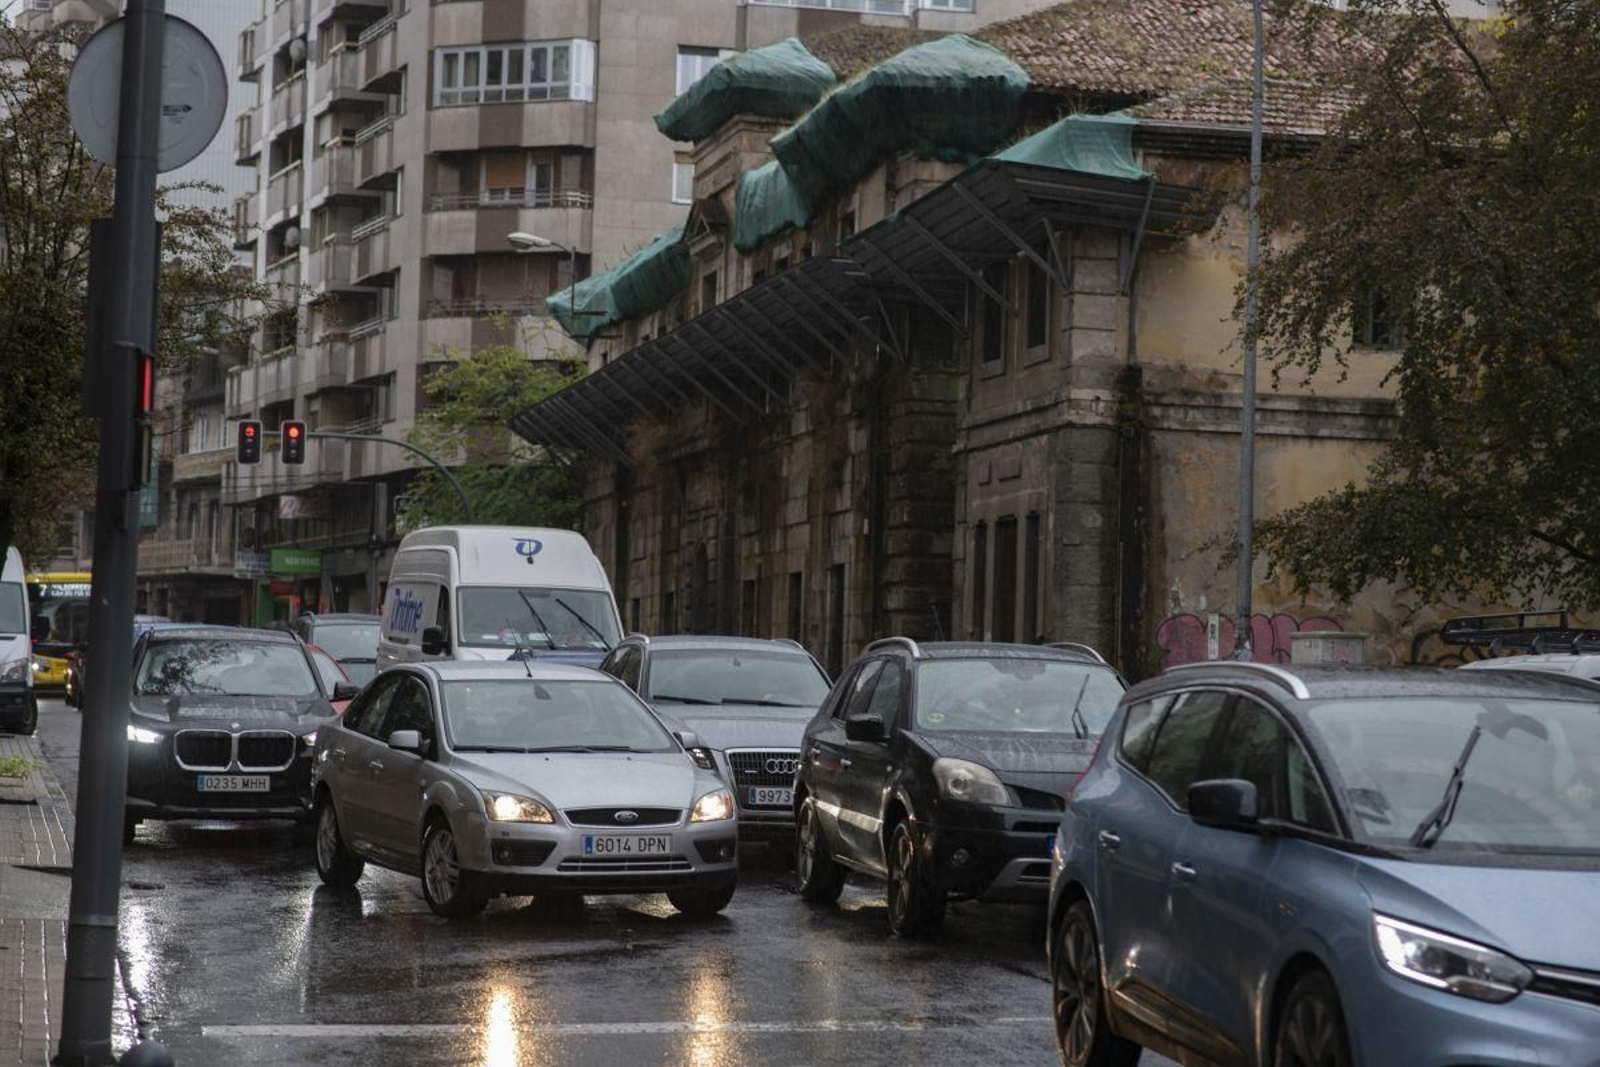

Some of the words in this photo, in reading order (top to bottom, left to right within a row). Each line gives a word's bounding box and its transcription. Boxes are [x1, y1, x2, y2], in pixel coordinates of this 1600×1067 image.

[39, 584, 47, 597] 7
[205, 777, 237, 790] 0235
[241, 778, 267, 790] MHH
[758, 789, 791, 803] 9973
[596, 838, 632, 853] 6014
[637, 838, 668, 853] DPN
